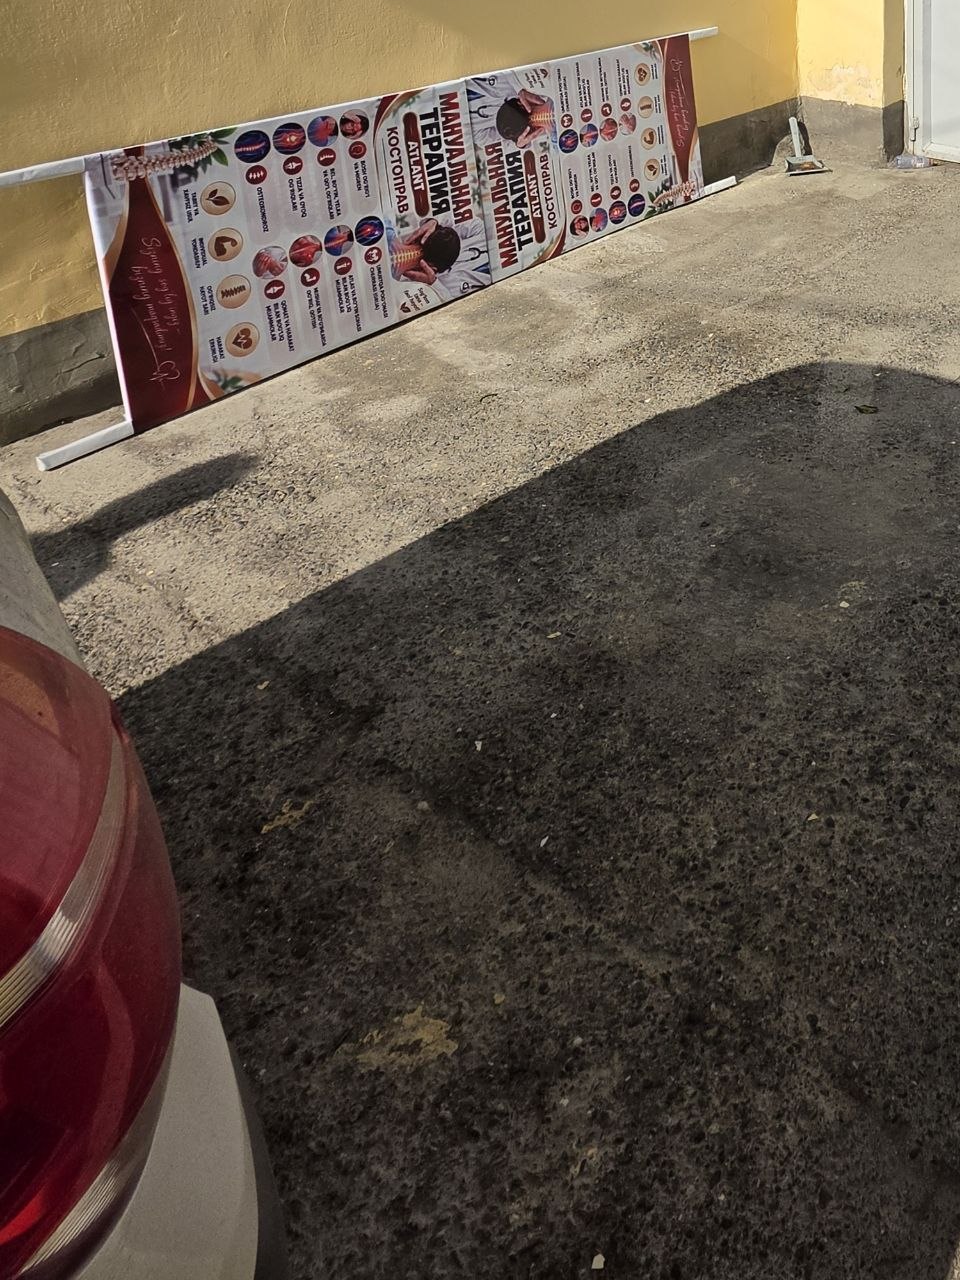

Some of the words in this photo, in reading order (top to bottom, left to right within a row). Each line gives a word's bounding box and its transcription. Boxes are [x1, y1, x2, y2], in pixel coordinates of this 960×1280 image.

[298, 192, 304, 200] VA
[353, 161, 358, 170] VA
[386, 125, 408, 214] КОСТОПРАВ
[407, 139, 424, 192] ATLANT
[418, 106, 450, 216] ТЕРАПИЯ
[438, 91, 472, 225] МАНУАЛЬНАЯ
[527, 171, 541, 219] ATLANT
[539, 152, 557, 230] КОСТОПРАВ
[484, 140, 518, 269] МАНУАЛЬНАЯ
[505, 149, 533, 251] ТЕРАПИЯ
